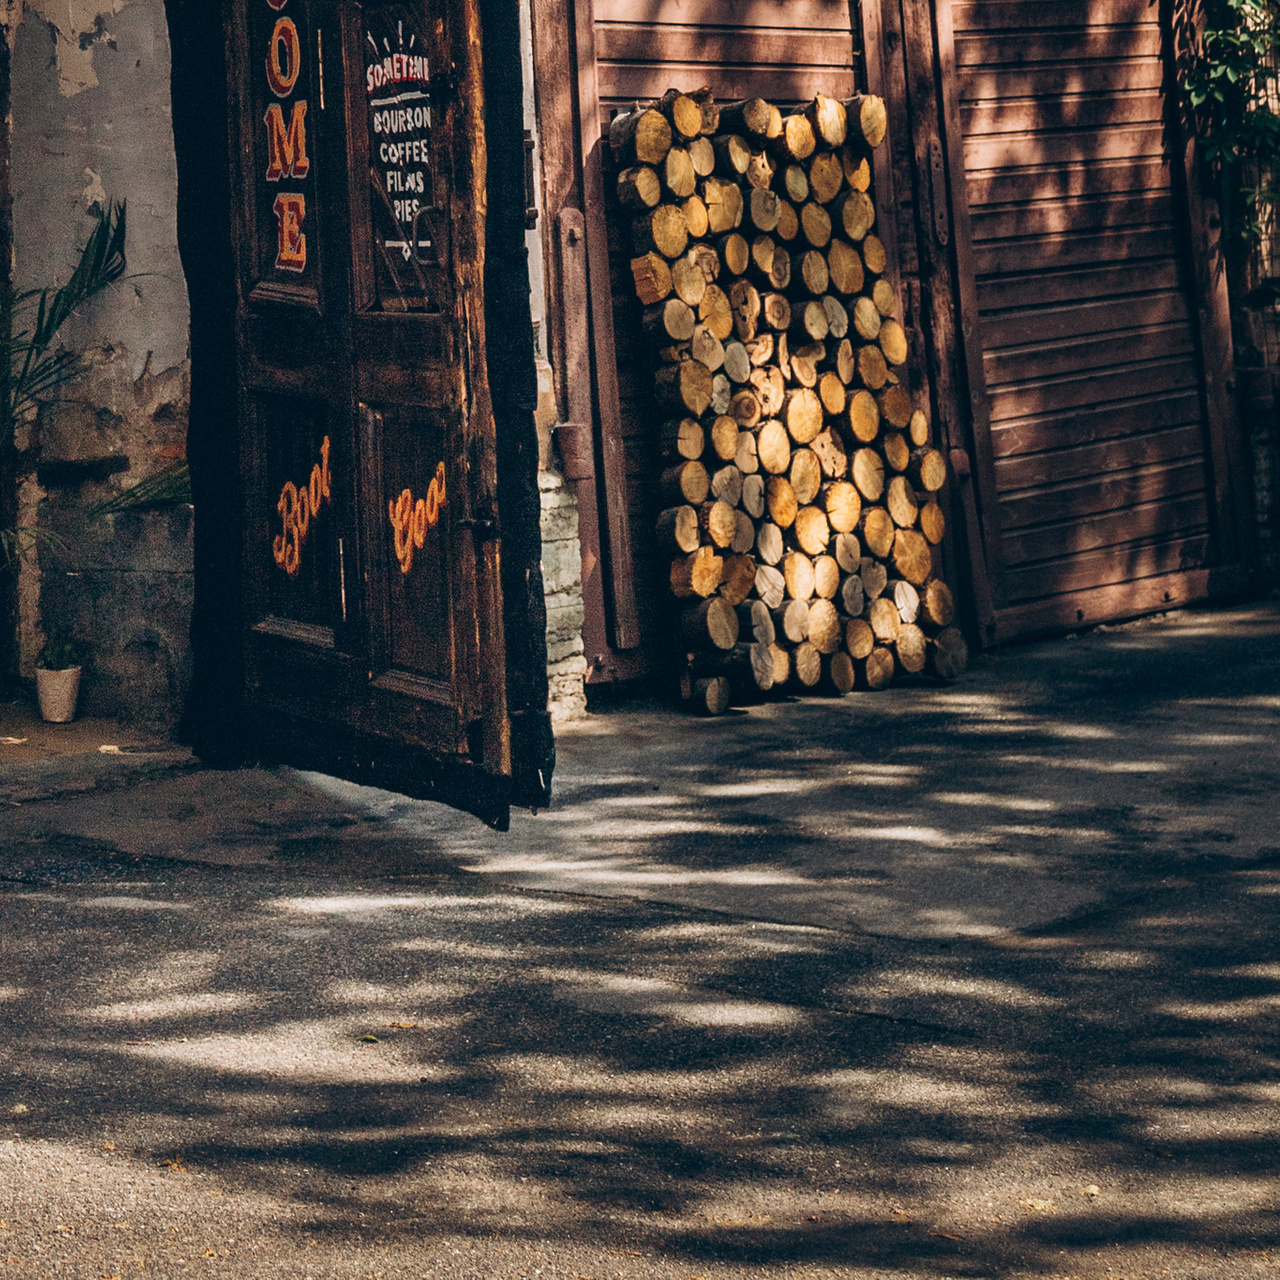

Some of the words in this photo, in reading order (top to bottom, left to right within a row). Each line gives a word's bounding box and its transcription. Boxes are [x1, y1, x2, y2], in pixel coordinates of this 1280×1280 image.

[373, 106, 431, 134] BOURBON
[380, 139, 429, 166] COFFEE
[386, 171, 424, 193] FILMS
